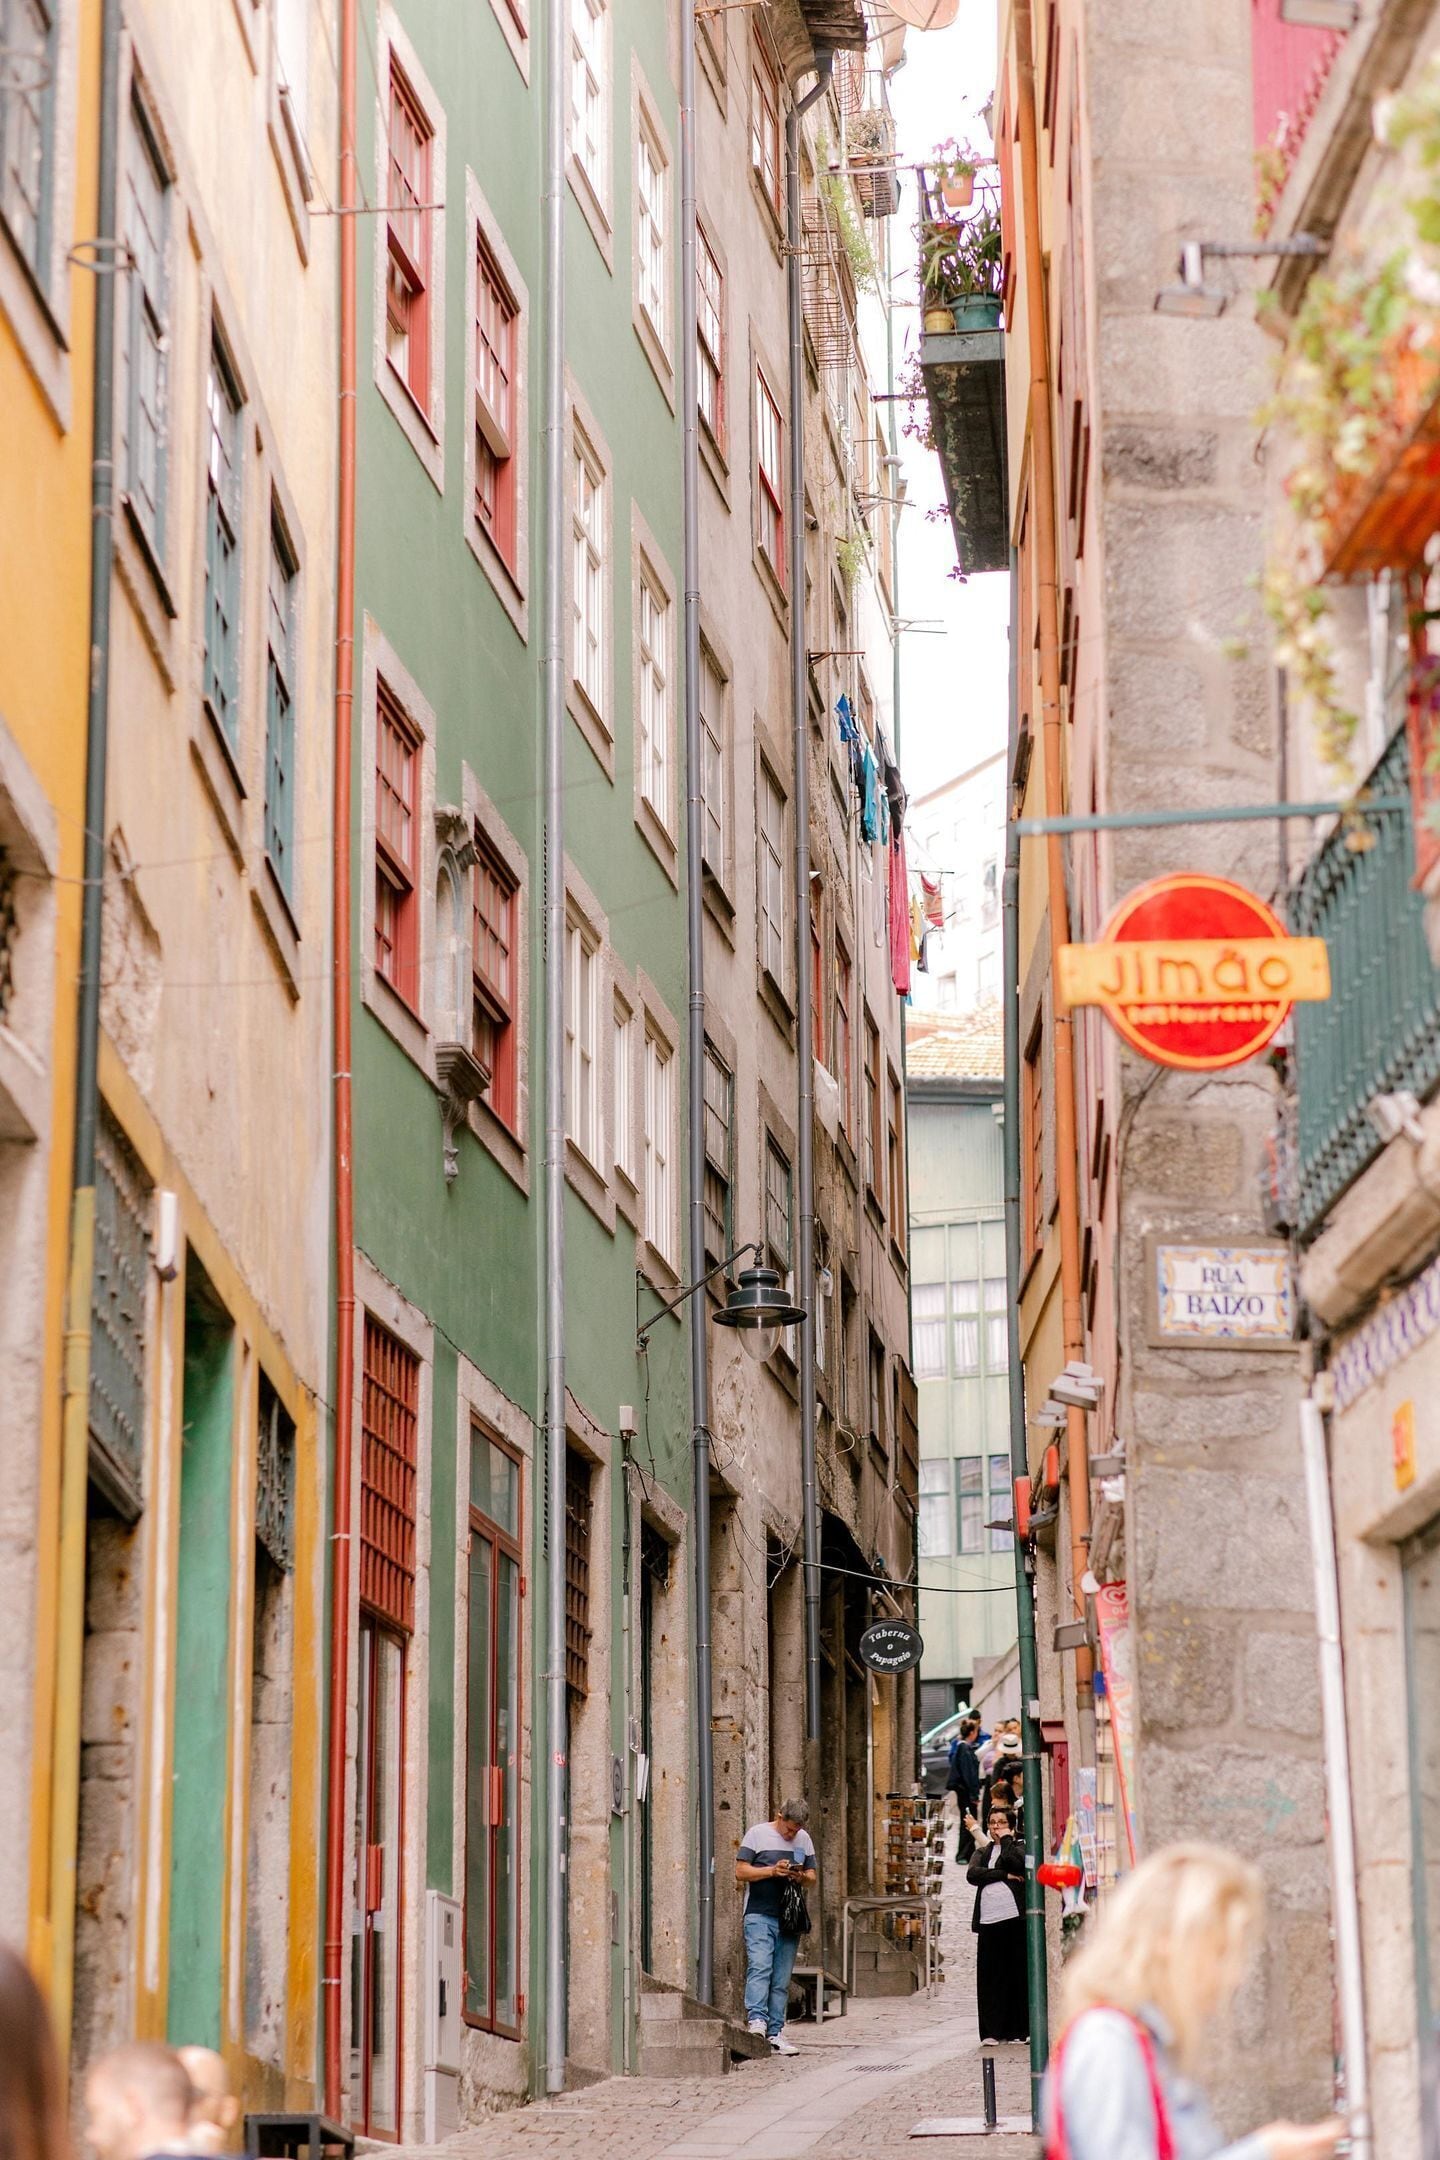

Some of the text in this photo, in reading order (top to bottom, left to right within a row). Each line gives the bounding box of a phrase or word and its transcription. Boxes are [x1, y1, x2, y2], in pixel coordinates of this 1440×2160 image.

[1202, 1267, 1245, 1284] RUA
[1187, 1294, 1264, 1317] BAIXO
[868, 1629, 911, 1643] Taberna
[869, 1651, 911, 1666] Papagaio
